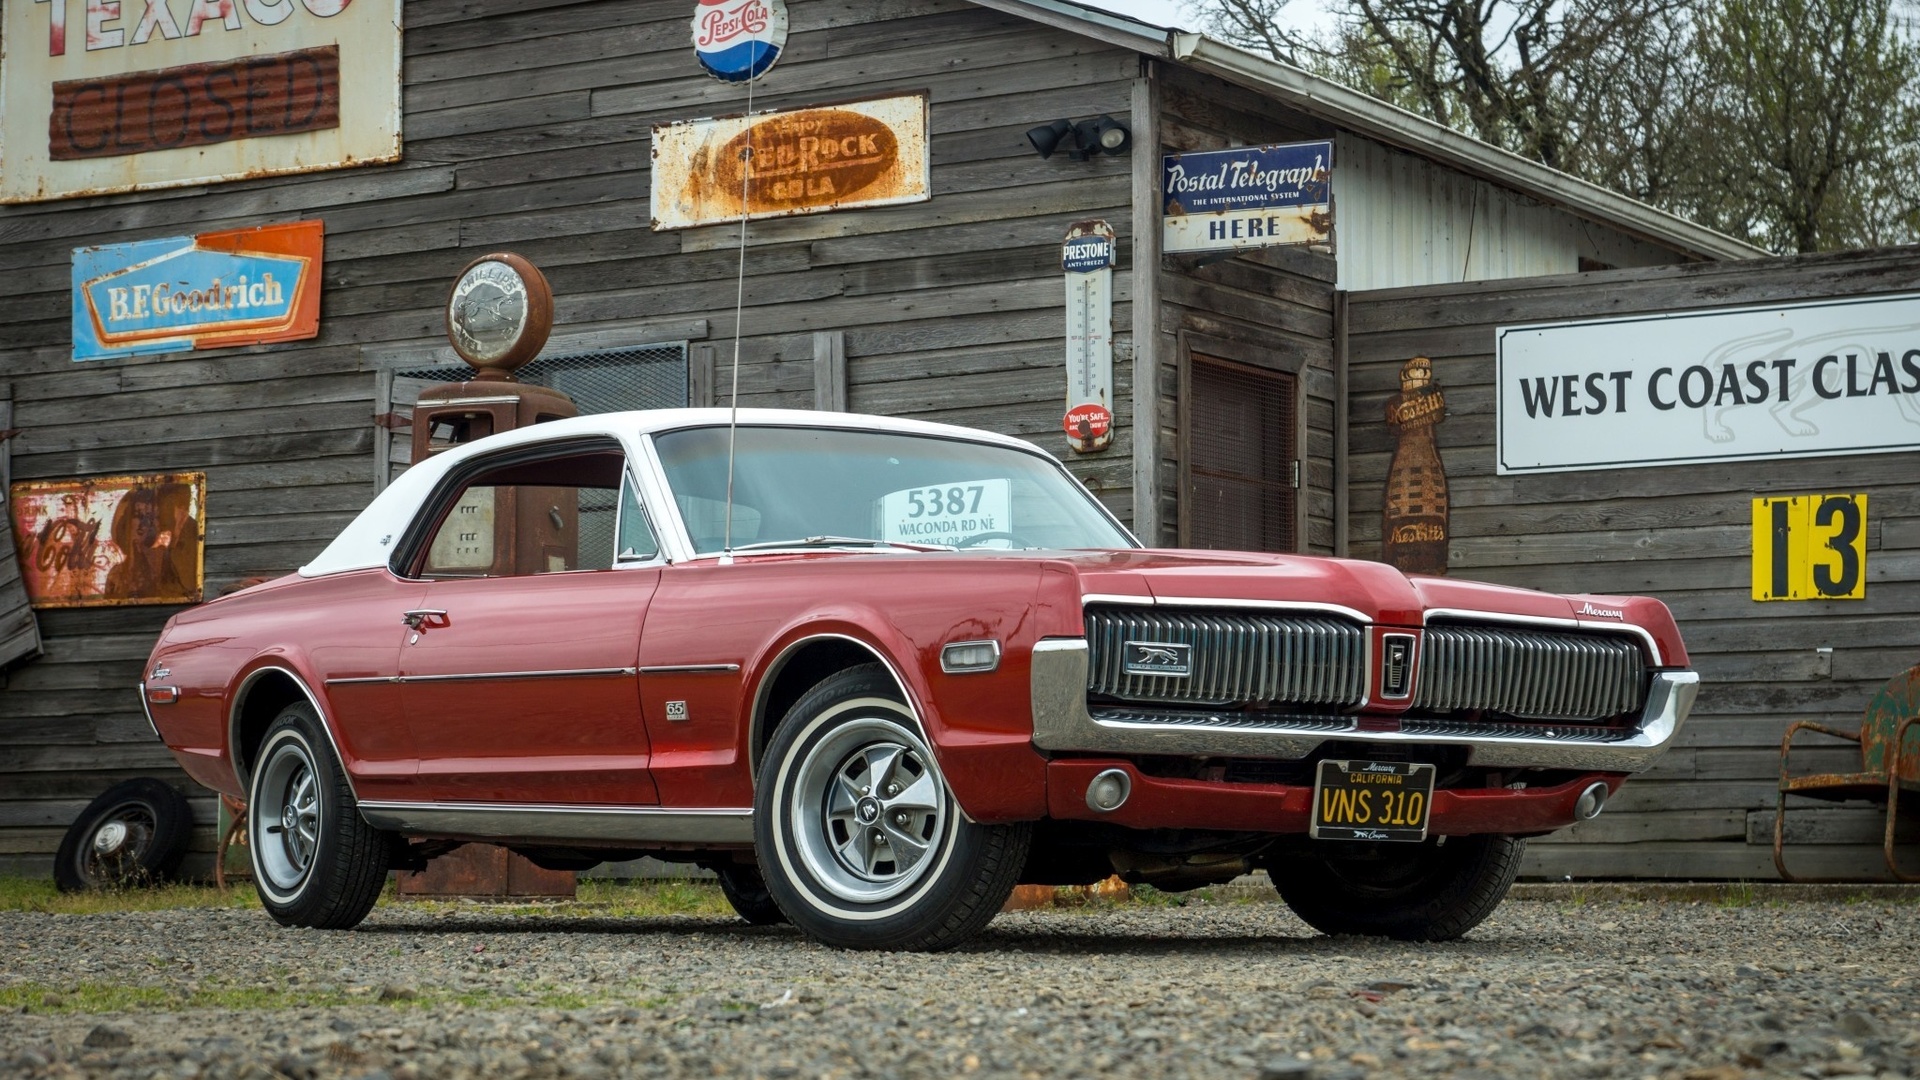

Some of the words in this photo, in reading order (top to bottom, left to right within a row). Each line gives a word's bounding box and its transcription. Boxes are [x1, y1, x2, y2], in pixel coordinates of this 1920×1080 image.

[34, 0, 352, 57] TEXA
[66, 54, 324, 154] CLOSED
[799, 132, 879, 173] ROCK
[1166, 162, 1229, 194] Postal
[1230, 154, 1325, 192] Telegraph
[773, 175, 836, 200] COLA
[1210, 194, 1268, 205] INTERNATIONAL
[1271, 190, 1300, 200] SYSTEM
[1209, 216, 1280, 240] HERE
[1063, 242, 1109, 261] PRESTONE
[1067, 259, 1104, 268] ANTI-FREEZE
[1519, 370, 1633, 419] WEST
[1647, 358, 1797, 411] COAST
[1812, 348, 1920, 401] CLAS
[908, 485, 985, 519] 5387
[898, 521, 958, 536] WACONDA
[961, 519, 977, 531] RD
[980, 518, 995, 530] NE
[1771, 496, 1861, 598] 13
[1577, 602, 1623, 621] Mercury
[1350, 773, 1403, 785] CALIFORNIA
[1362, 762, 1397, 773] Mercury
[1323, 788, 1372, 824] VNS
[1378, 790, 1424, 826] 310
